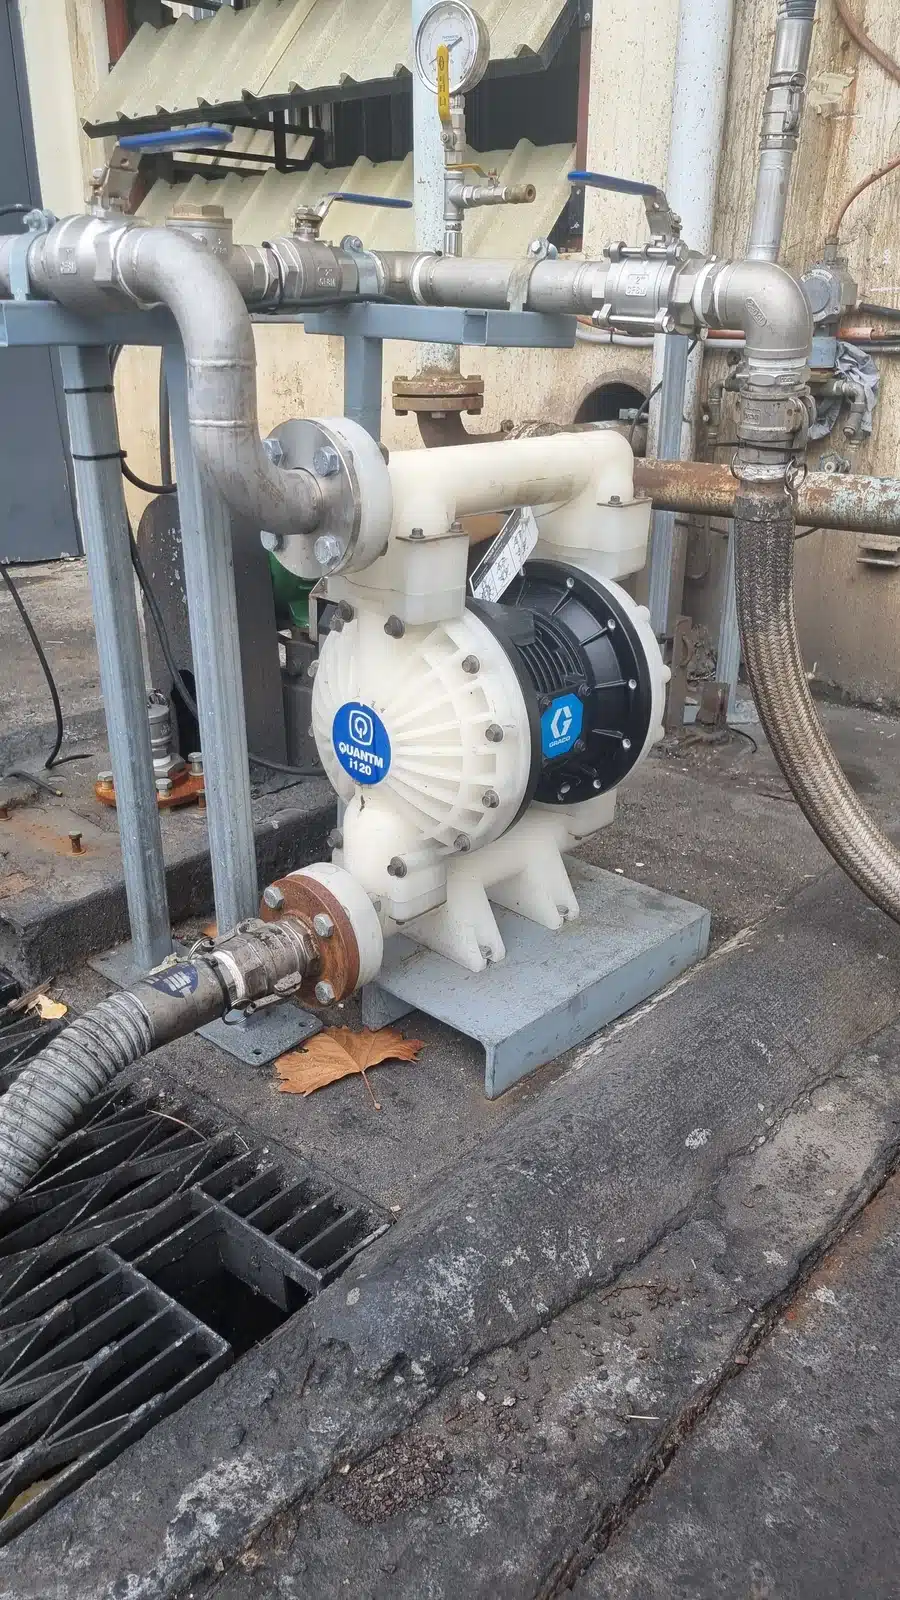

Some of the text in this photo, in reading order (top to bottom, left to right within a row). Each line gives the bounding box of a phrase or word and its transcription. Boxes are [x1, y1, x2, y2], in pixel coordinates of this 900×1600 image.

[549, 736, 571, 748] GRACO
[339, 741, 384, 769] QUANTM
[349, 758, 372, 776] i120
